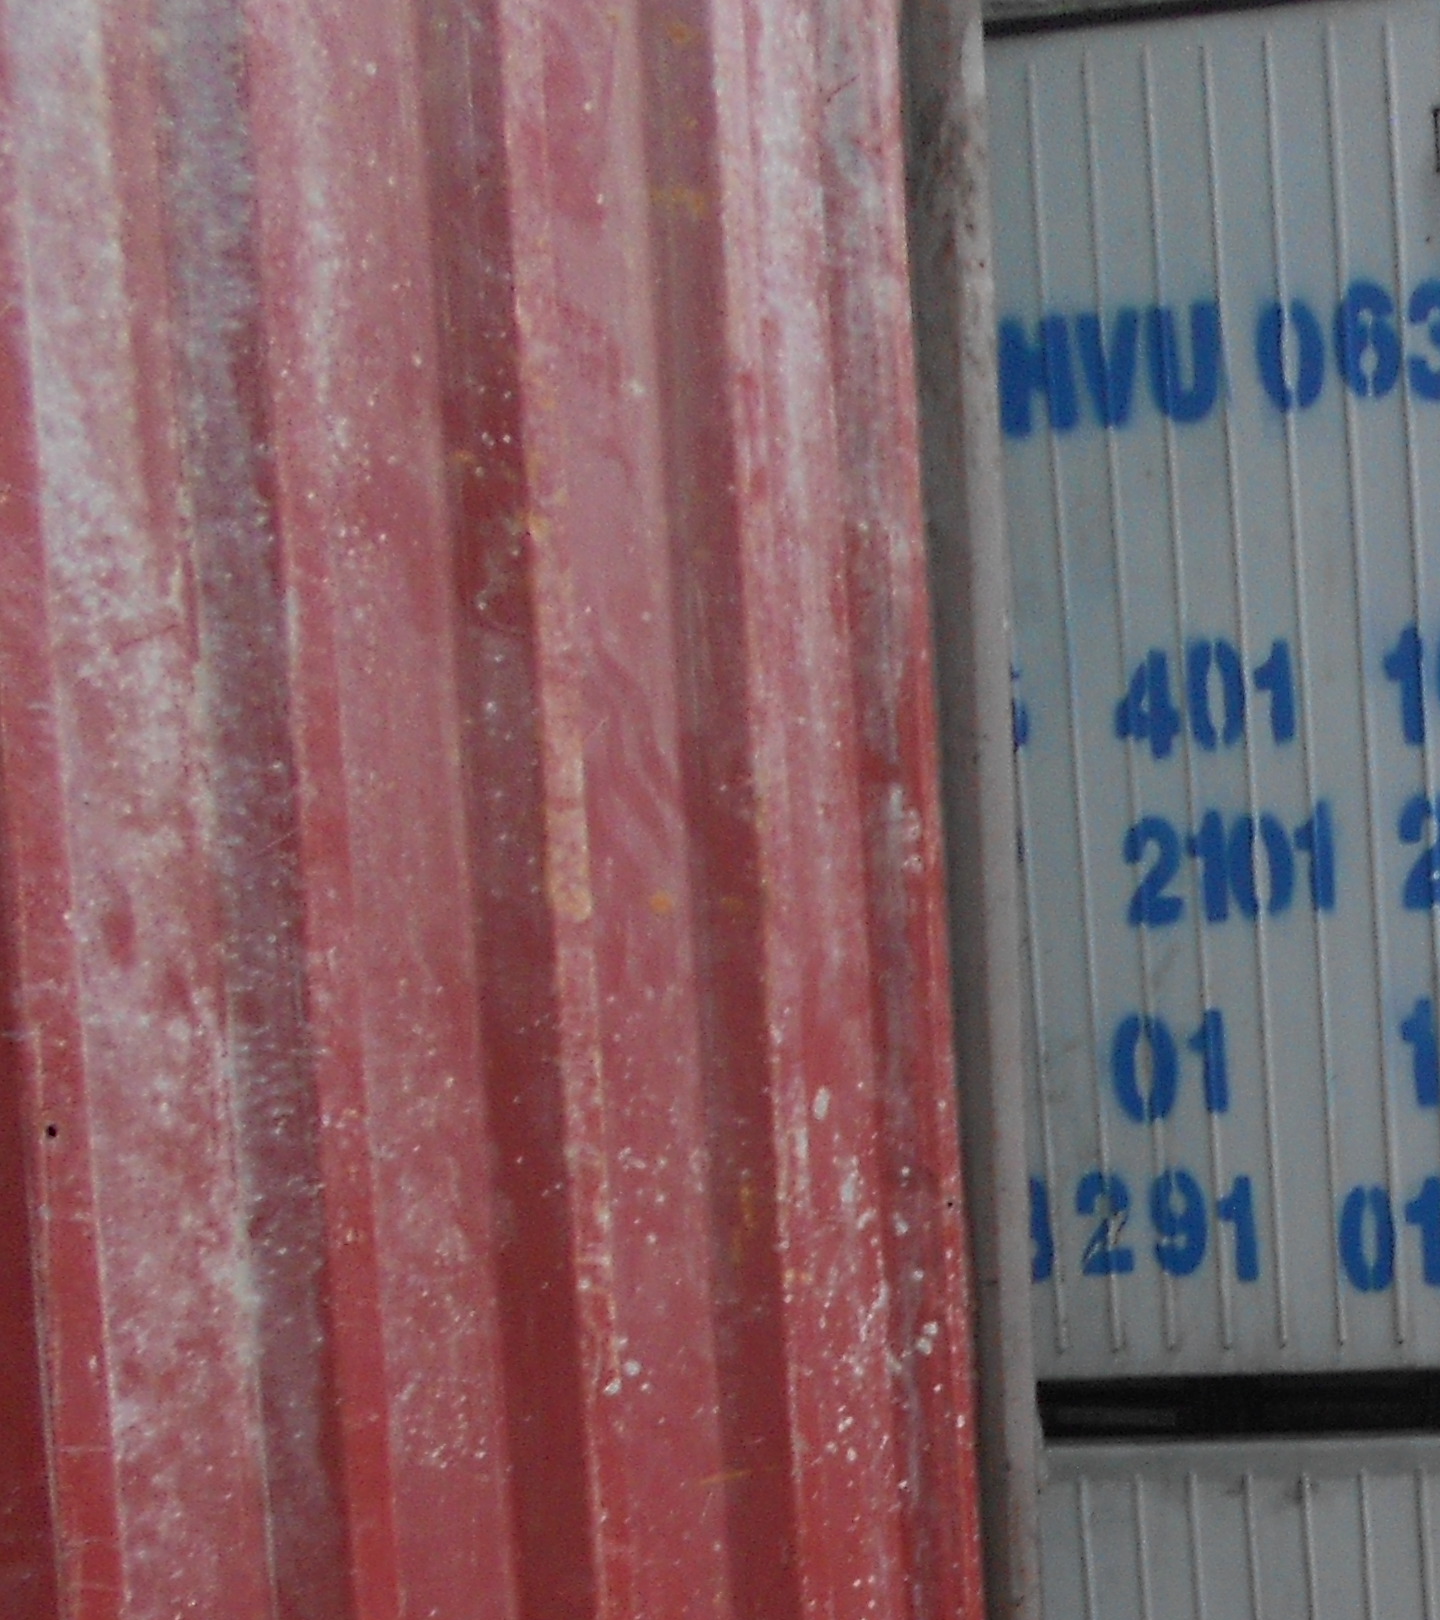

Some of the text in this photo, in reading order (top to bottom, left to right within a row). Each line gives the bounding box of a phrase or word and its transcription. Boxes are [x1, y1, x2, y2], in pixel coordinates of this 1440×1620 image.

[1113, 637, 1297, 761] 401
[1124, 801, 1338, 928] 2101
[1110, 1007, 1231, 1125] 01
